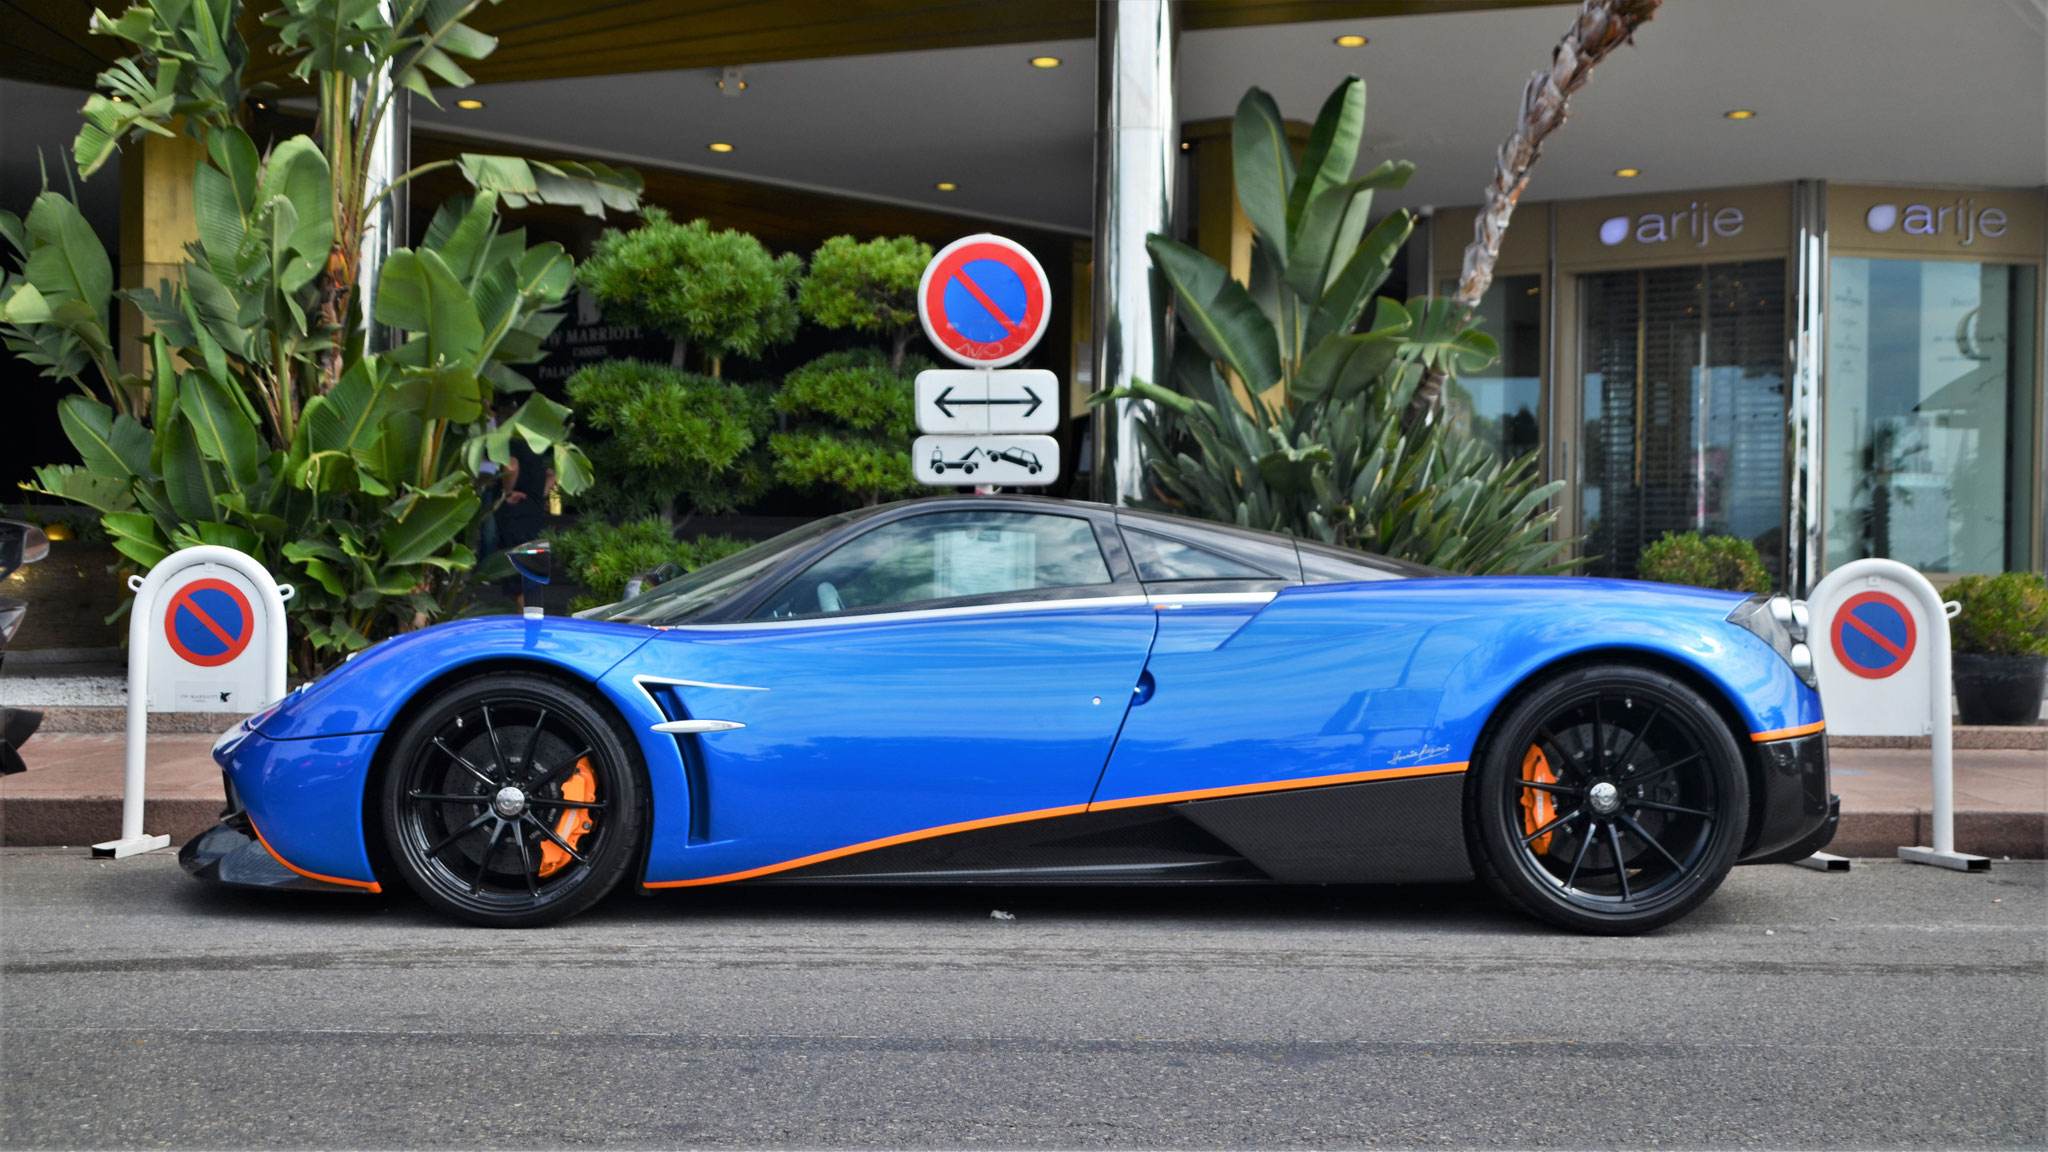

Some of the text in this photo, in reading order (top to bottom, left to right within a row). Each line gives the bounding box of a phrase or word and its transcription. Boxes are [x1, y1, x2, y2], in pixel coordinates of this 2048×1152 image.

[1636, 201, 1744, 248] arije
[1903, 198, 2008, 246] arije
[566, 325, 641, 344] MARRIOTT
